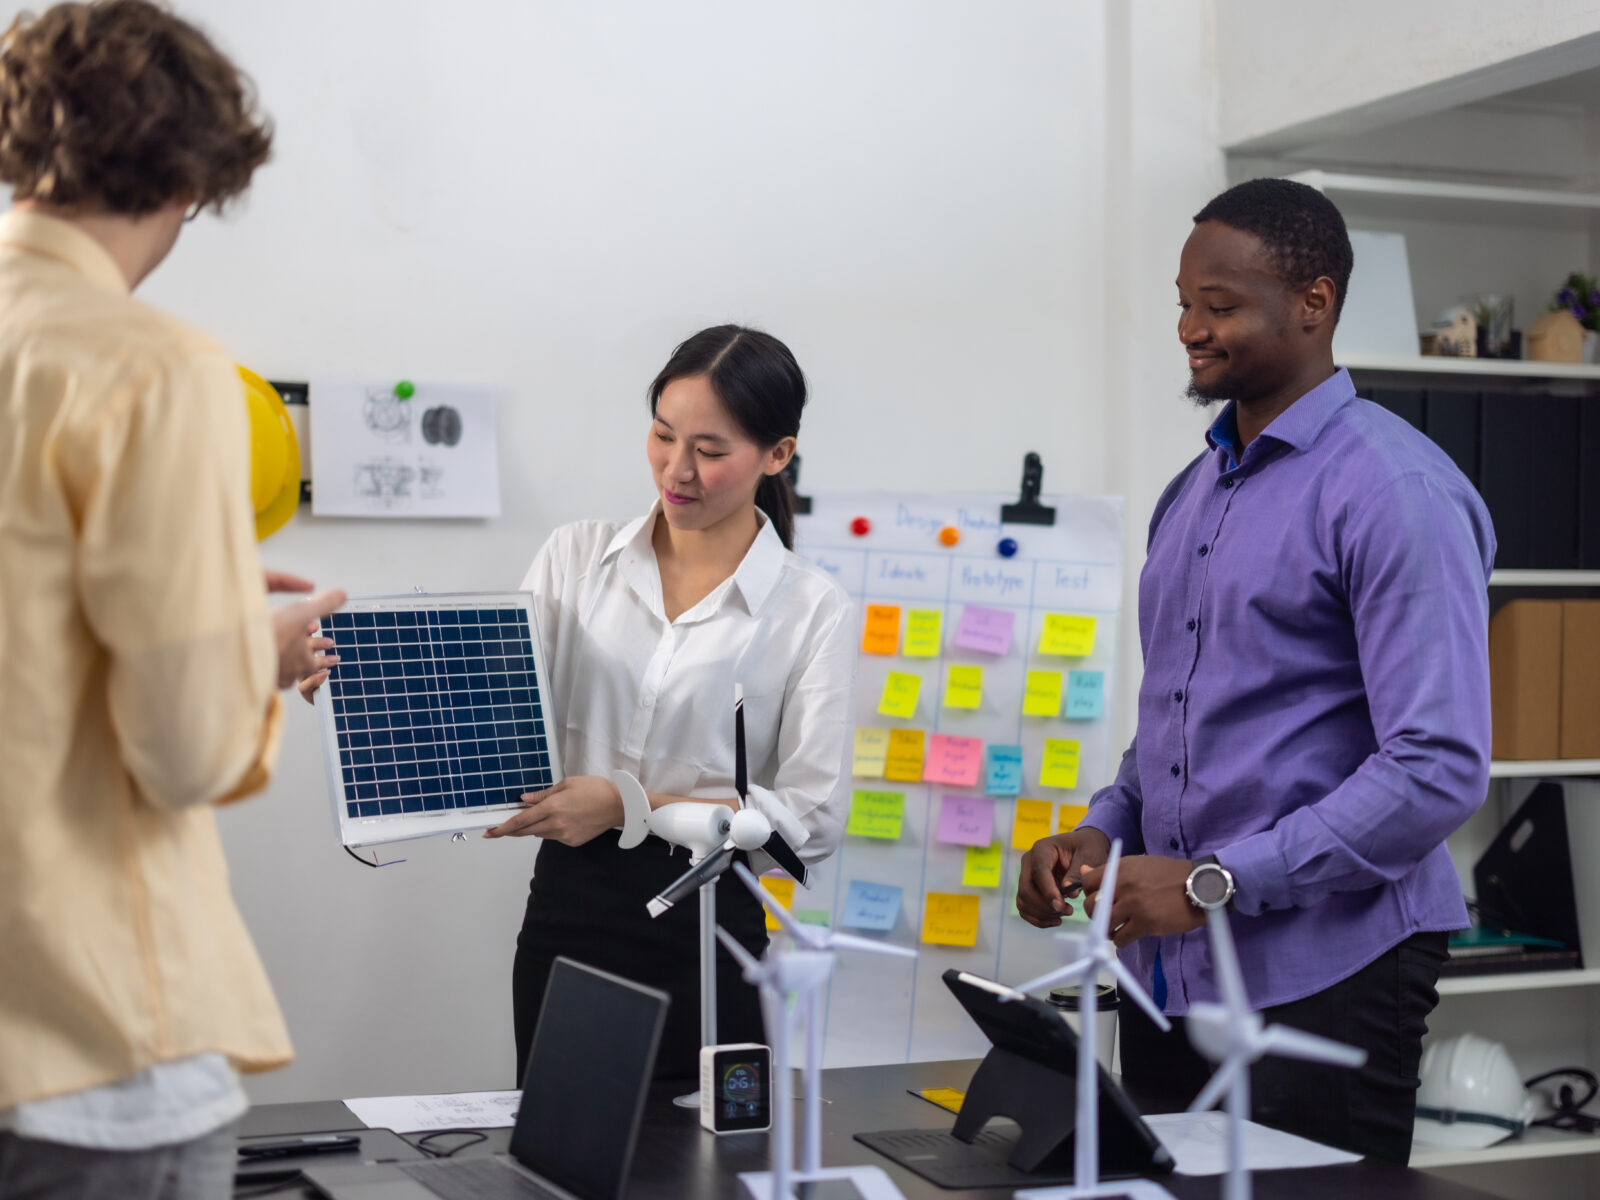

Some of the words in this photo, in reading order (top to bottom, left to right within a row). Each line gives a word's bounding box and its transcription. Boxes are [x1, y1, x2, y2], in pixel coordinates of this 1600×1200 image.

[896, 502, 945, 536] Design
[880, 559, 926, 580] Ideate
[962, 566, 1024, 595] Prototype
[1056, 567, 1090, 589] Test
